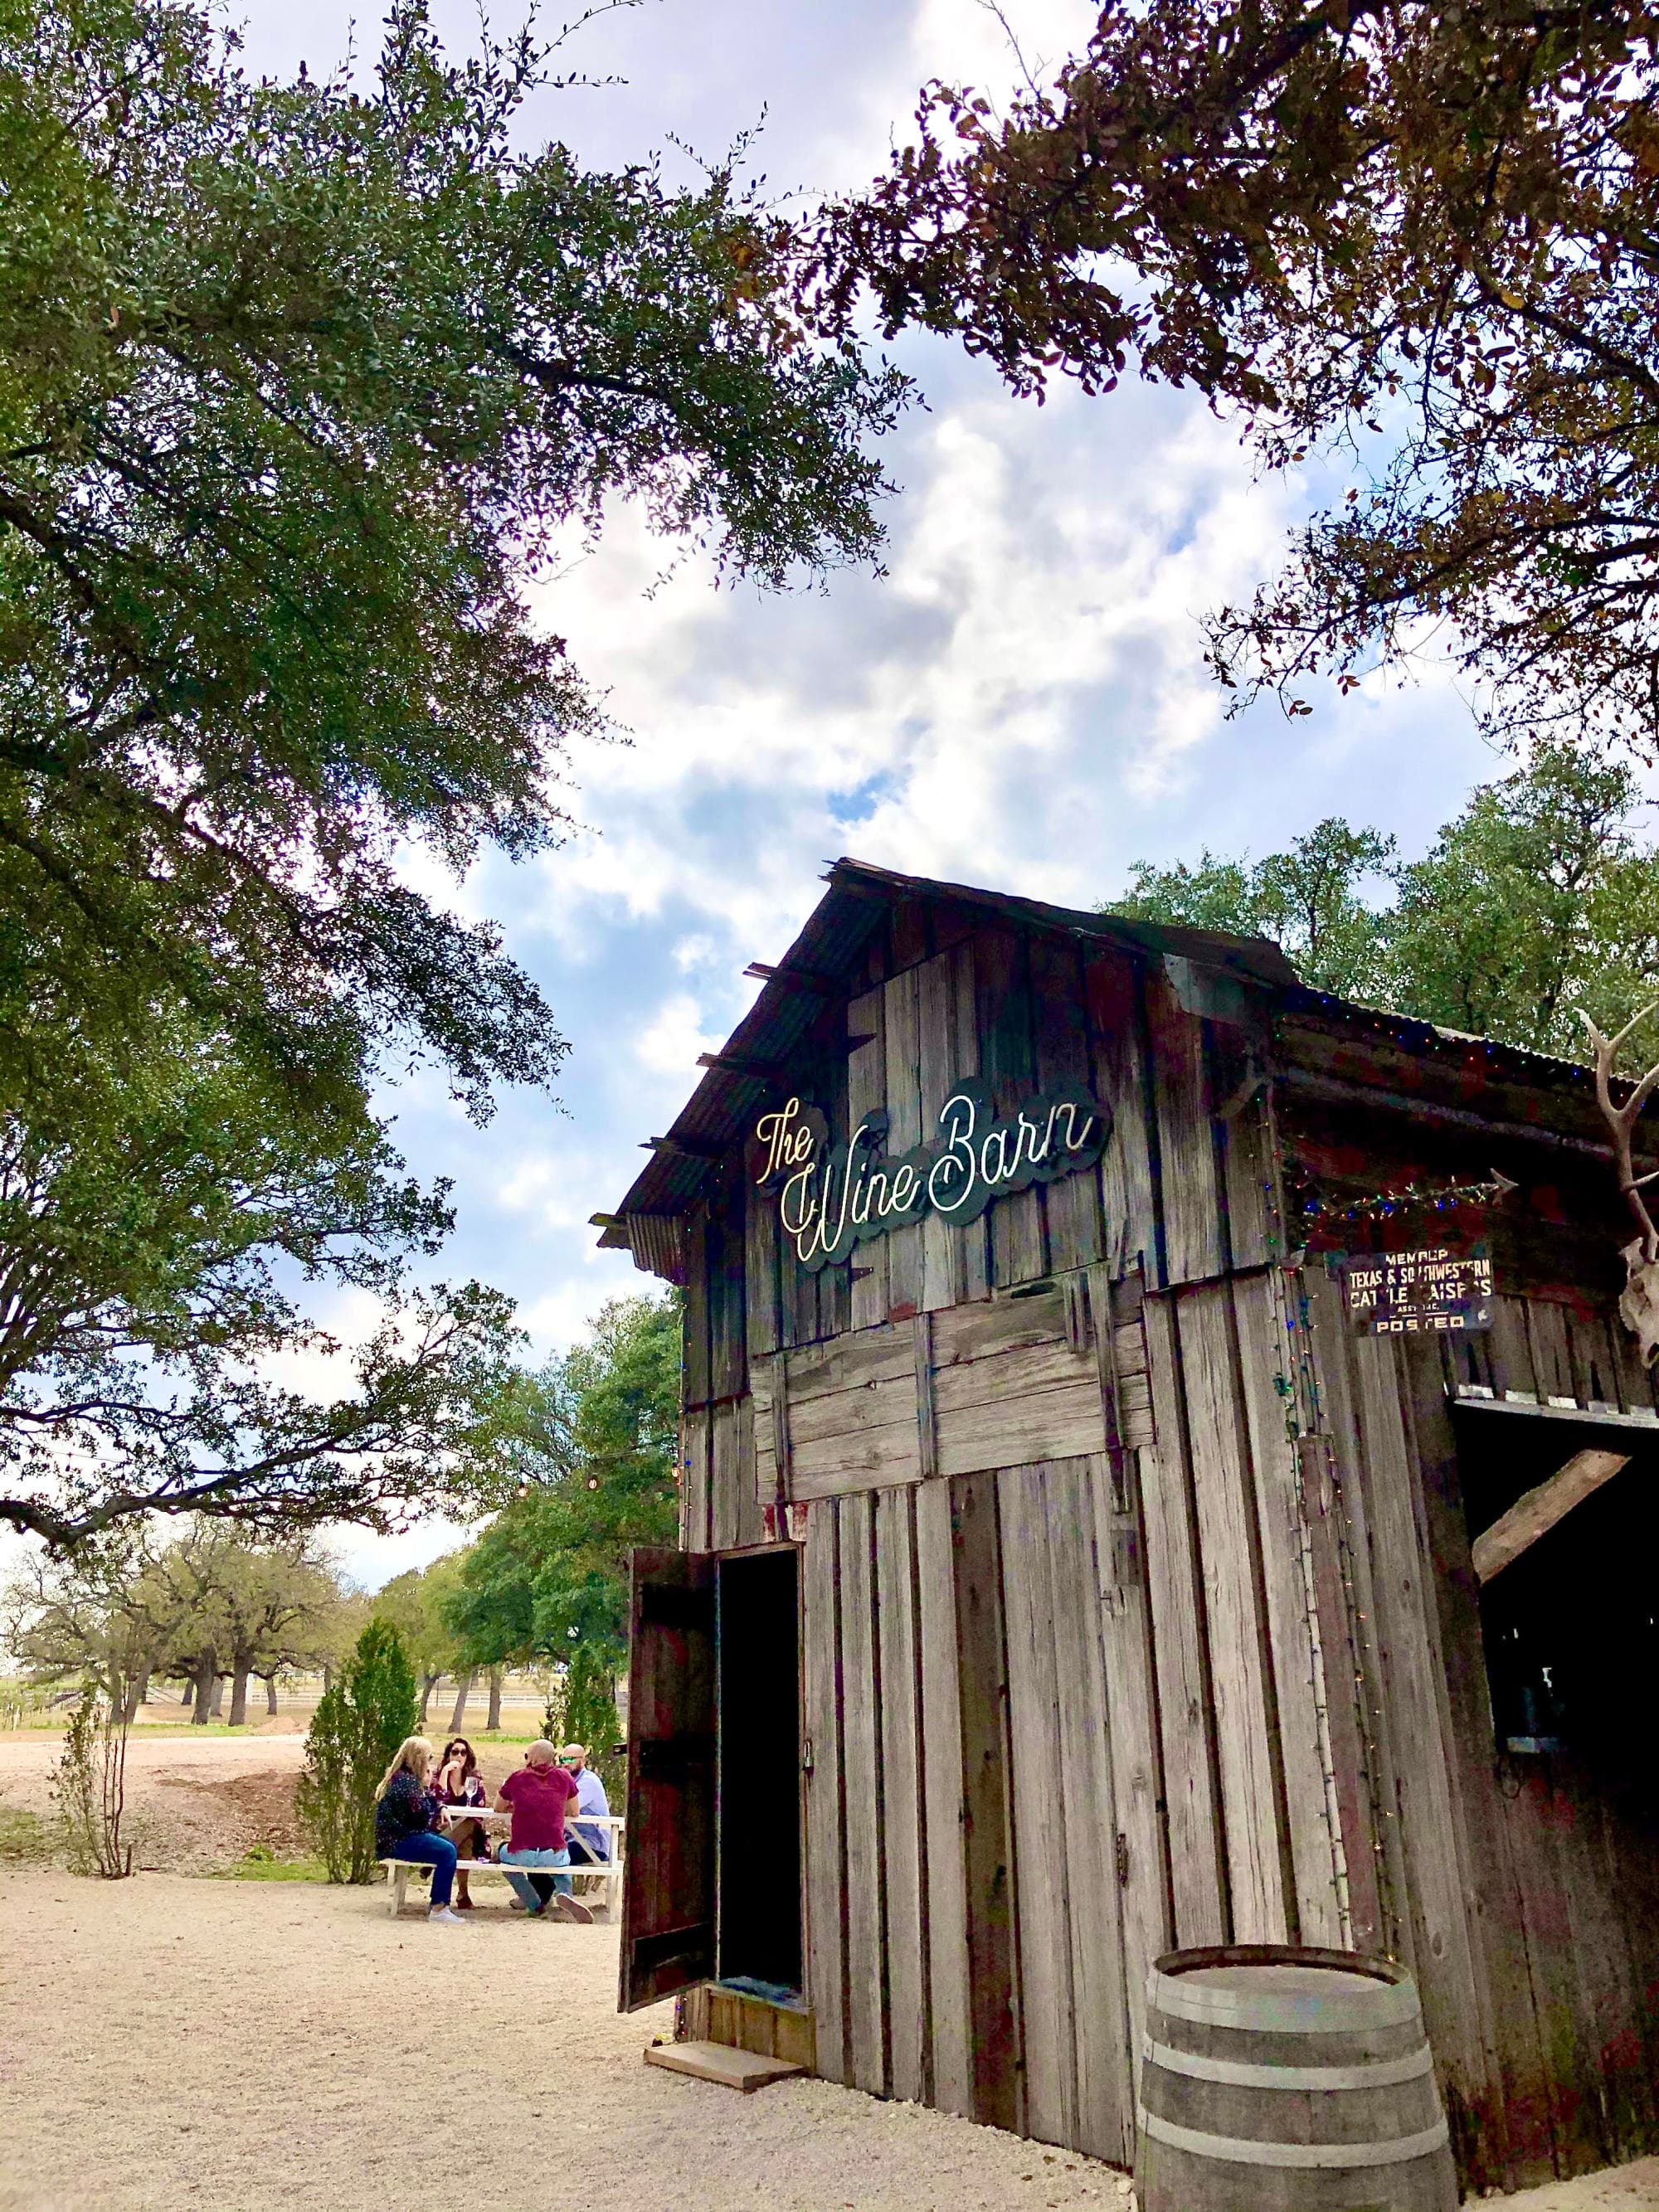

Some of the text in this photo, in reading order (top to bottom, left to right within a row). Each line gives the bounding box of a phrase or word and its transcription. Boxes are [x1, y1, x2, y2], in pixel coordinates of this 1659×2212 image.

[757, 1096, 815, 1184] The
[781, 1095, 1094, 1262] Wine Barn
[1349, 1270, 1383, 1289] TEXAS
[1386, 1268, 1397, 1285] &
[1350, 1279, 1491, 1308] CATLE AISES
